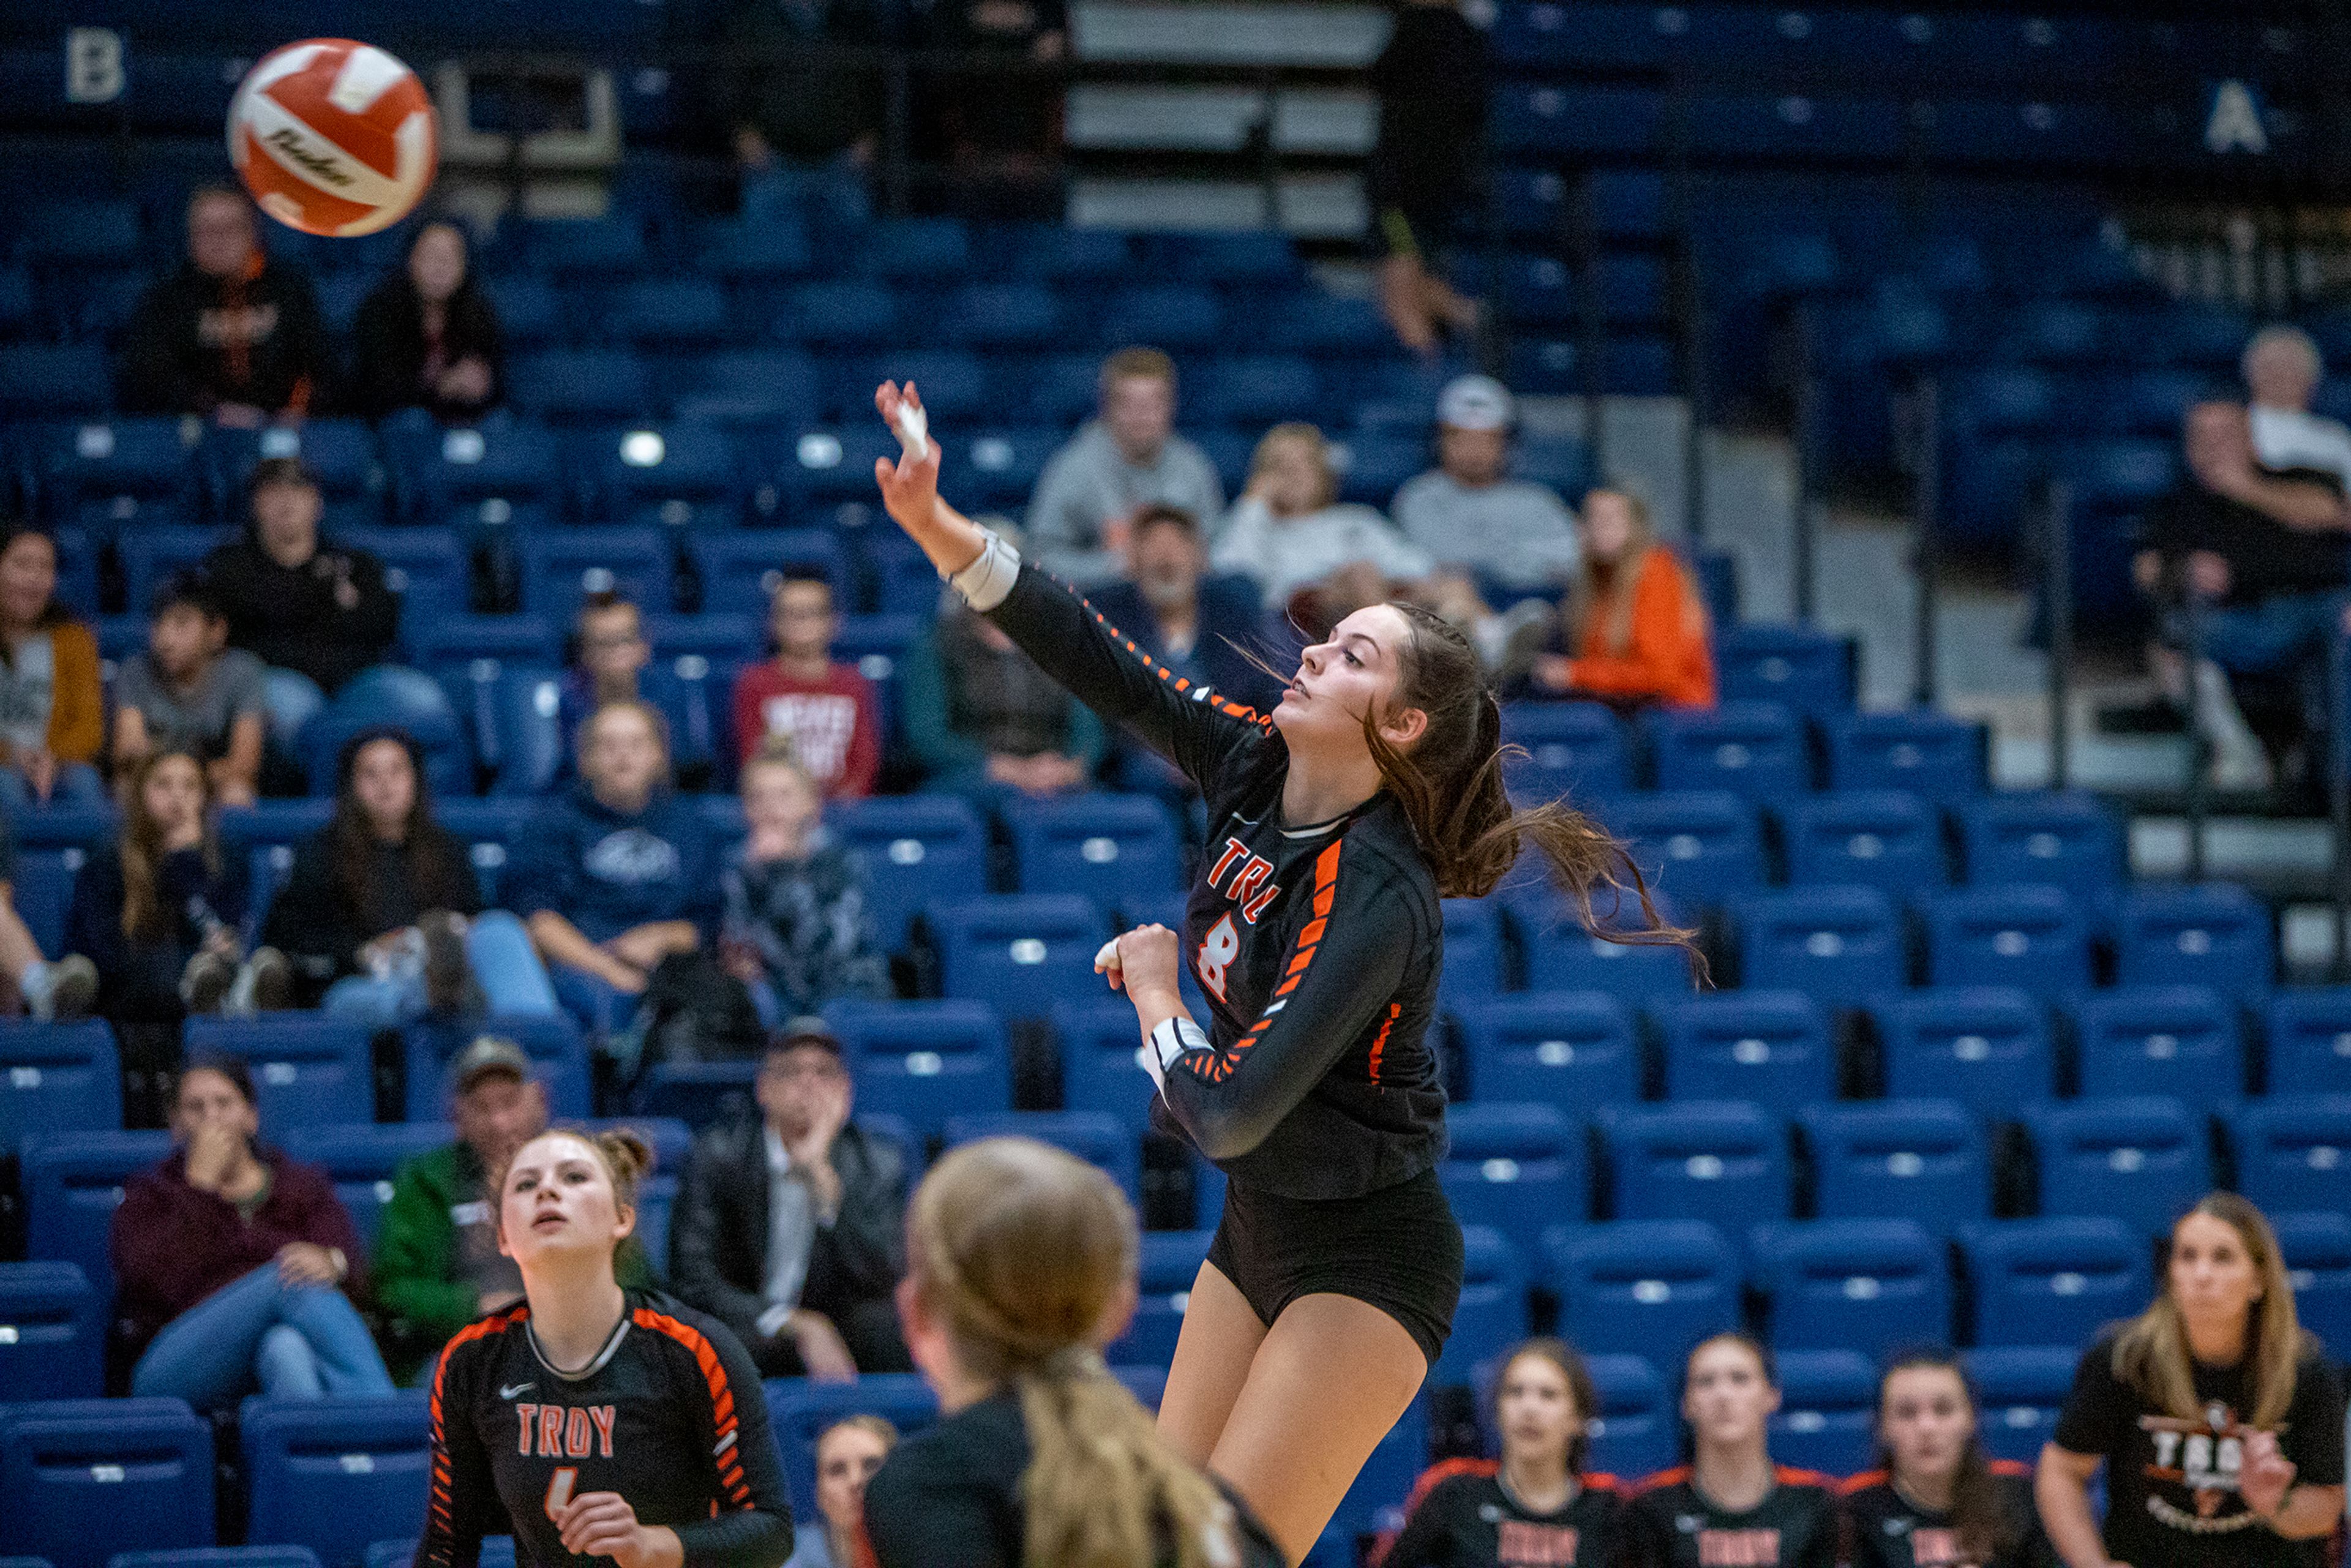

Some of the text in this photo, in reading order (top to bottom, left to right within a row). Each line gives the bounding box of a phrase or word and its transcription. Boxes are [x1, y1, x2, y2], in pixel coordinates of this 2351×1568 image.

[69, 26, 124, 103] B
[2207, 78, 2267, 153] A
[1196, 910, 1240, 1004] 8
[516, 1402, 617, 1459] TROY
